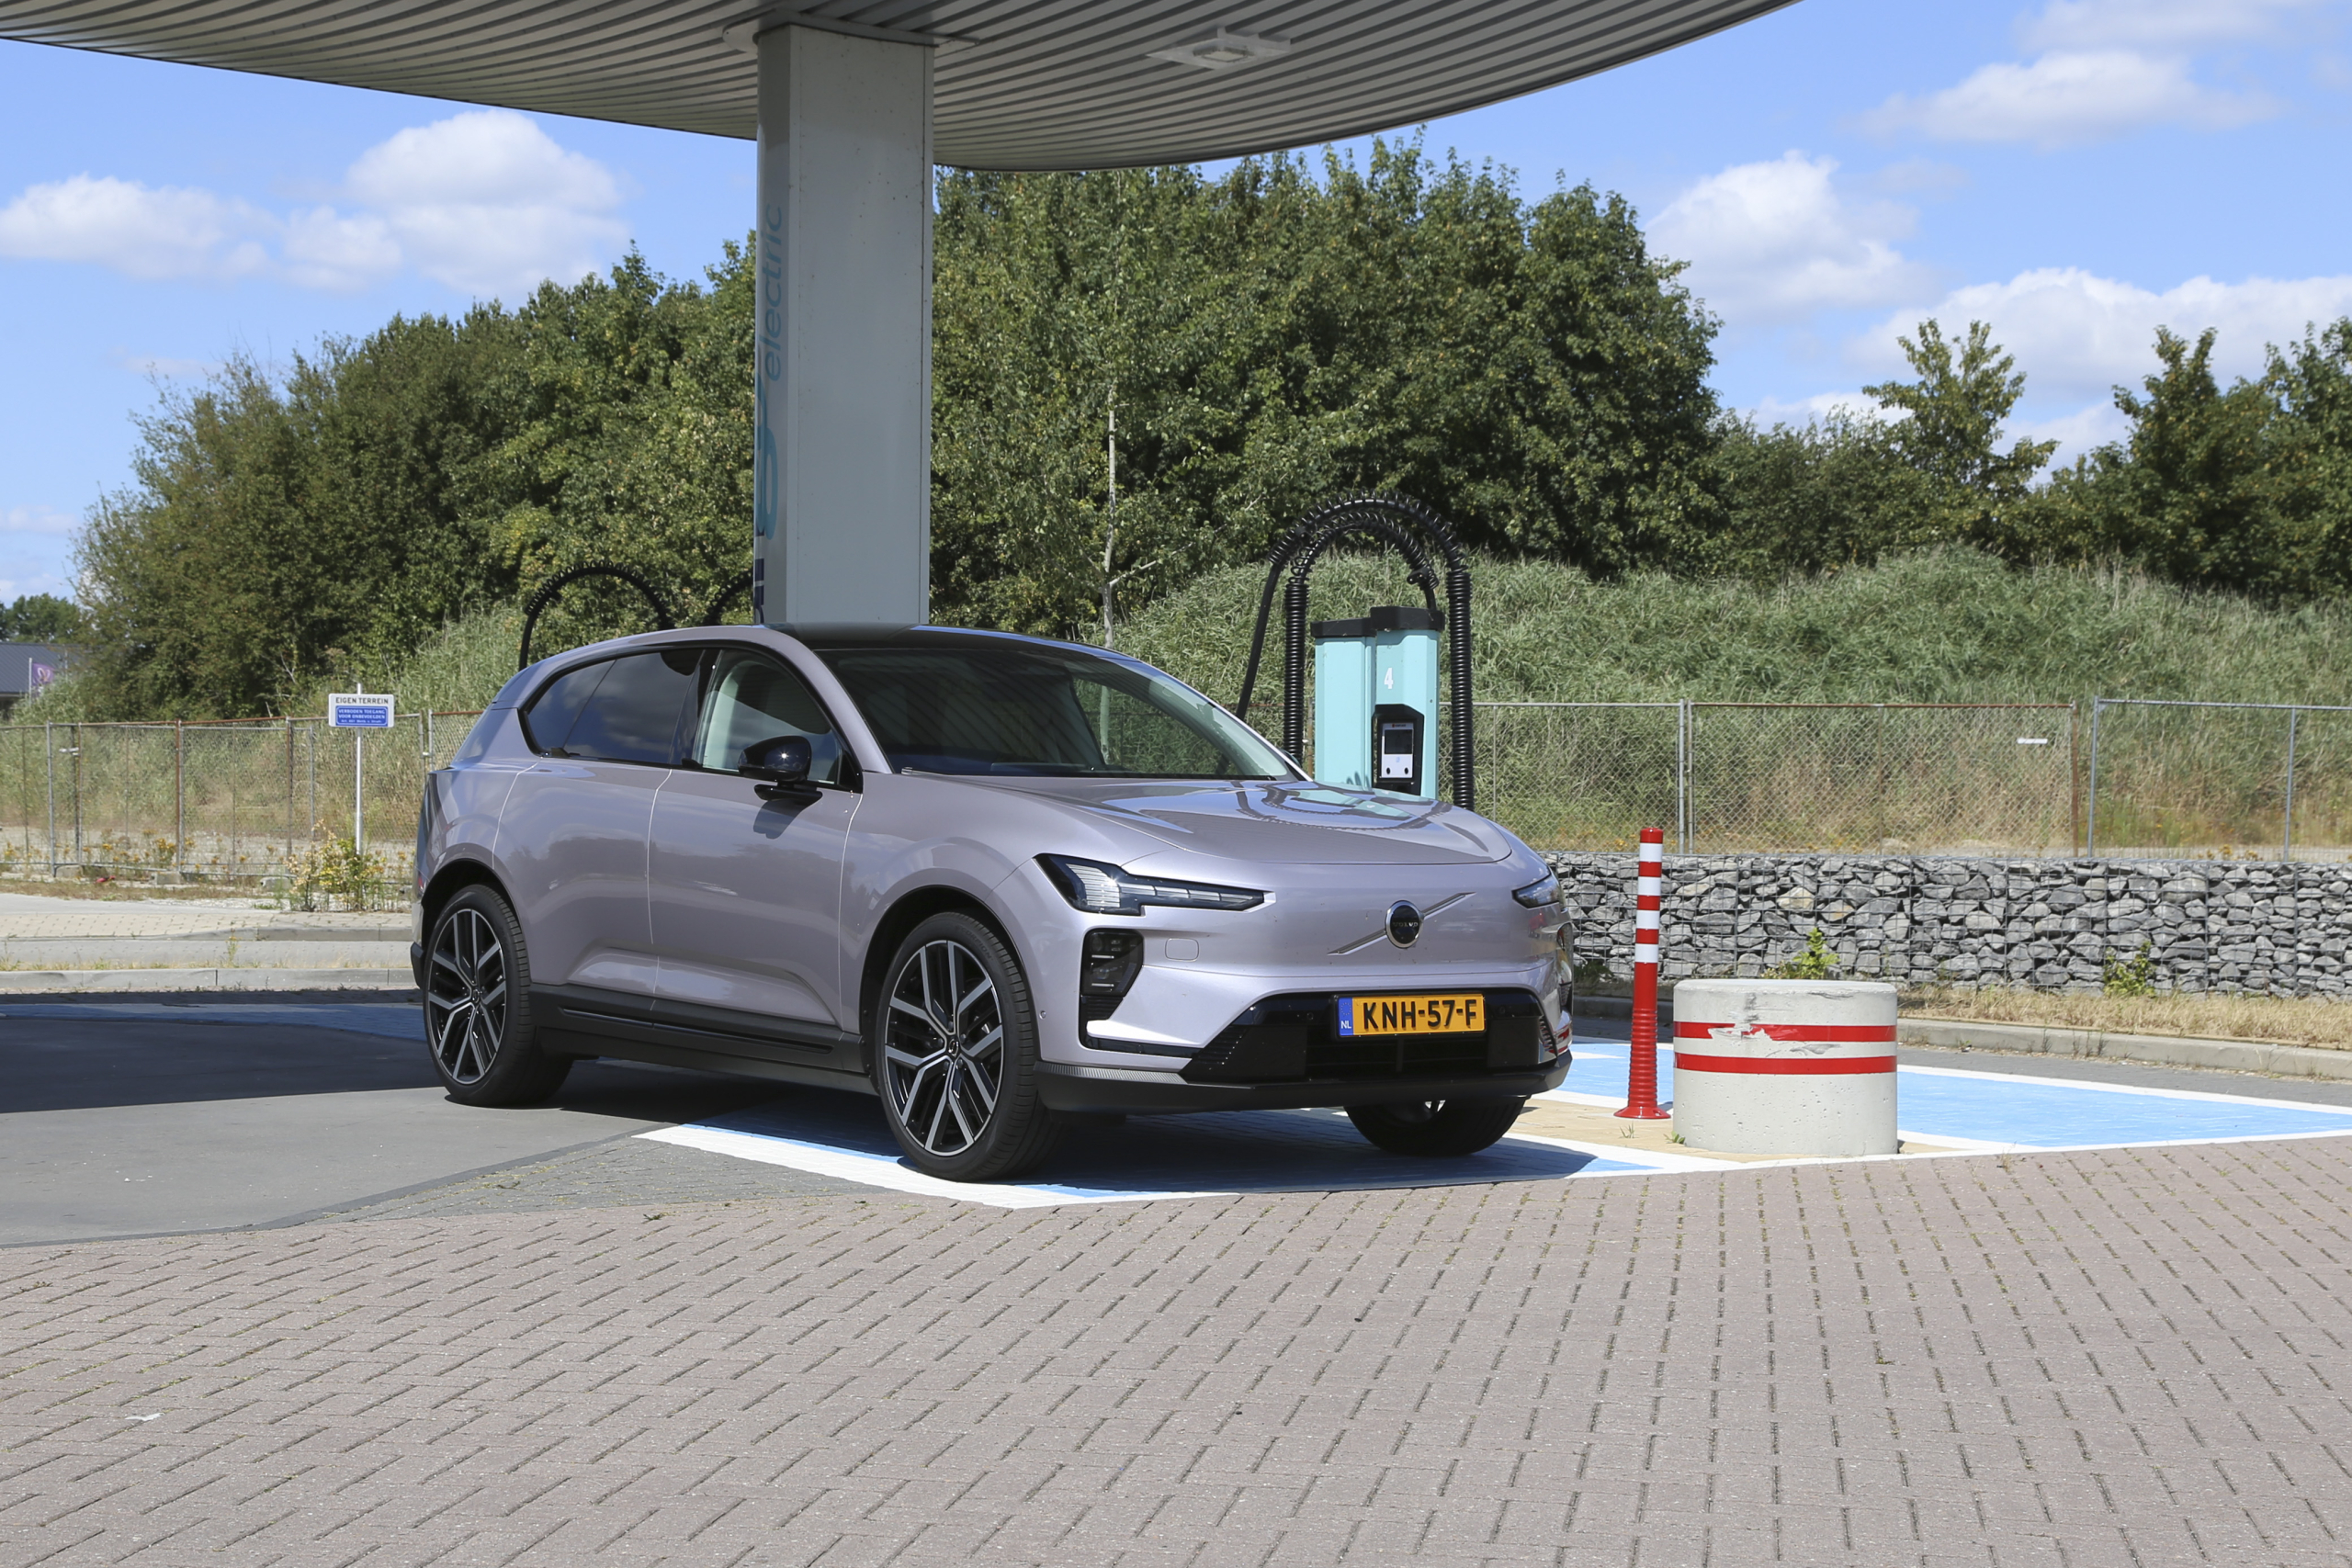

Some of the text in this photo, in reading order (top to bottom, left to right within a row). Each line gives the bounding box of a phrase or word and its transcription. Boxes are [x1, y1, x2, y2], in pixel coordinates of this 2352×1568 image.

[759, 203, 781, 381] electric
[1384, 667, 1394, 689] 4
[1340, 998, 1477, 1030] NL KNH-57-F
